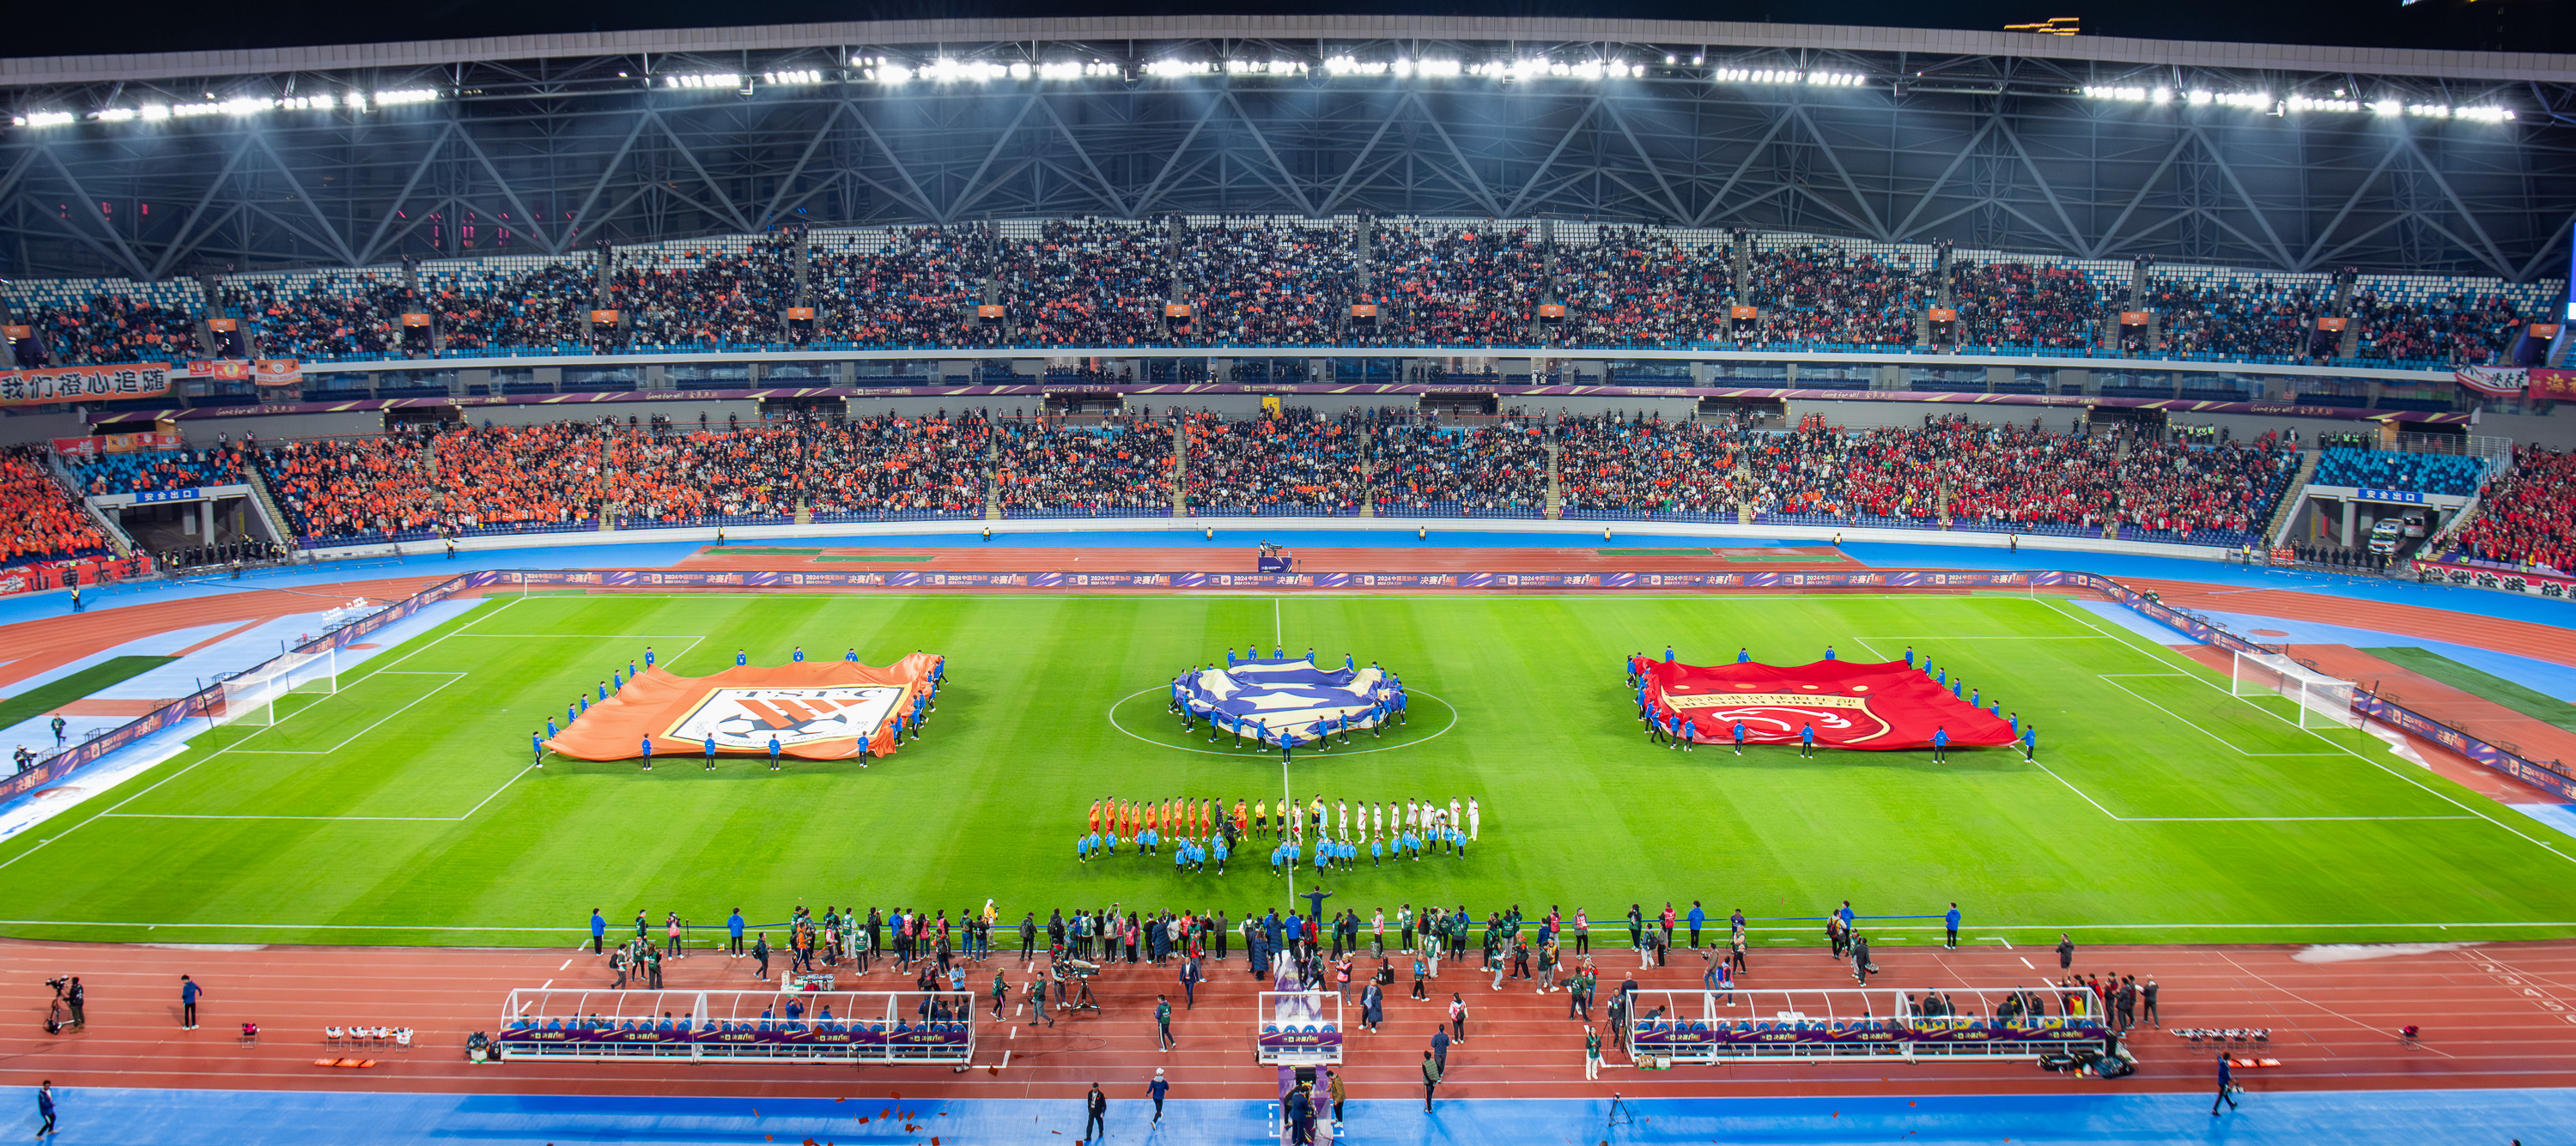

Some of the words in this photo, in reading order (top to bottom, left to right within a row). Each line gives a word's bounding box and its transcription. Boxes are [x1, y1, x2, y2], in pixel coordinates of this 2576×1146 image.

[1, 367, 167, 400] 我们橙心追随
[144, 489, 192, 501] 安全出口
[2366, 490, 2415, 502] 安全出口
[2477, 963, 2502, 973] 2
[2498, 975, 2521, 985] 3
[2524, 988, 2543, 997] 4
[2542, 1001, 2565, 1011] 5
